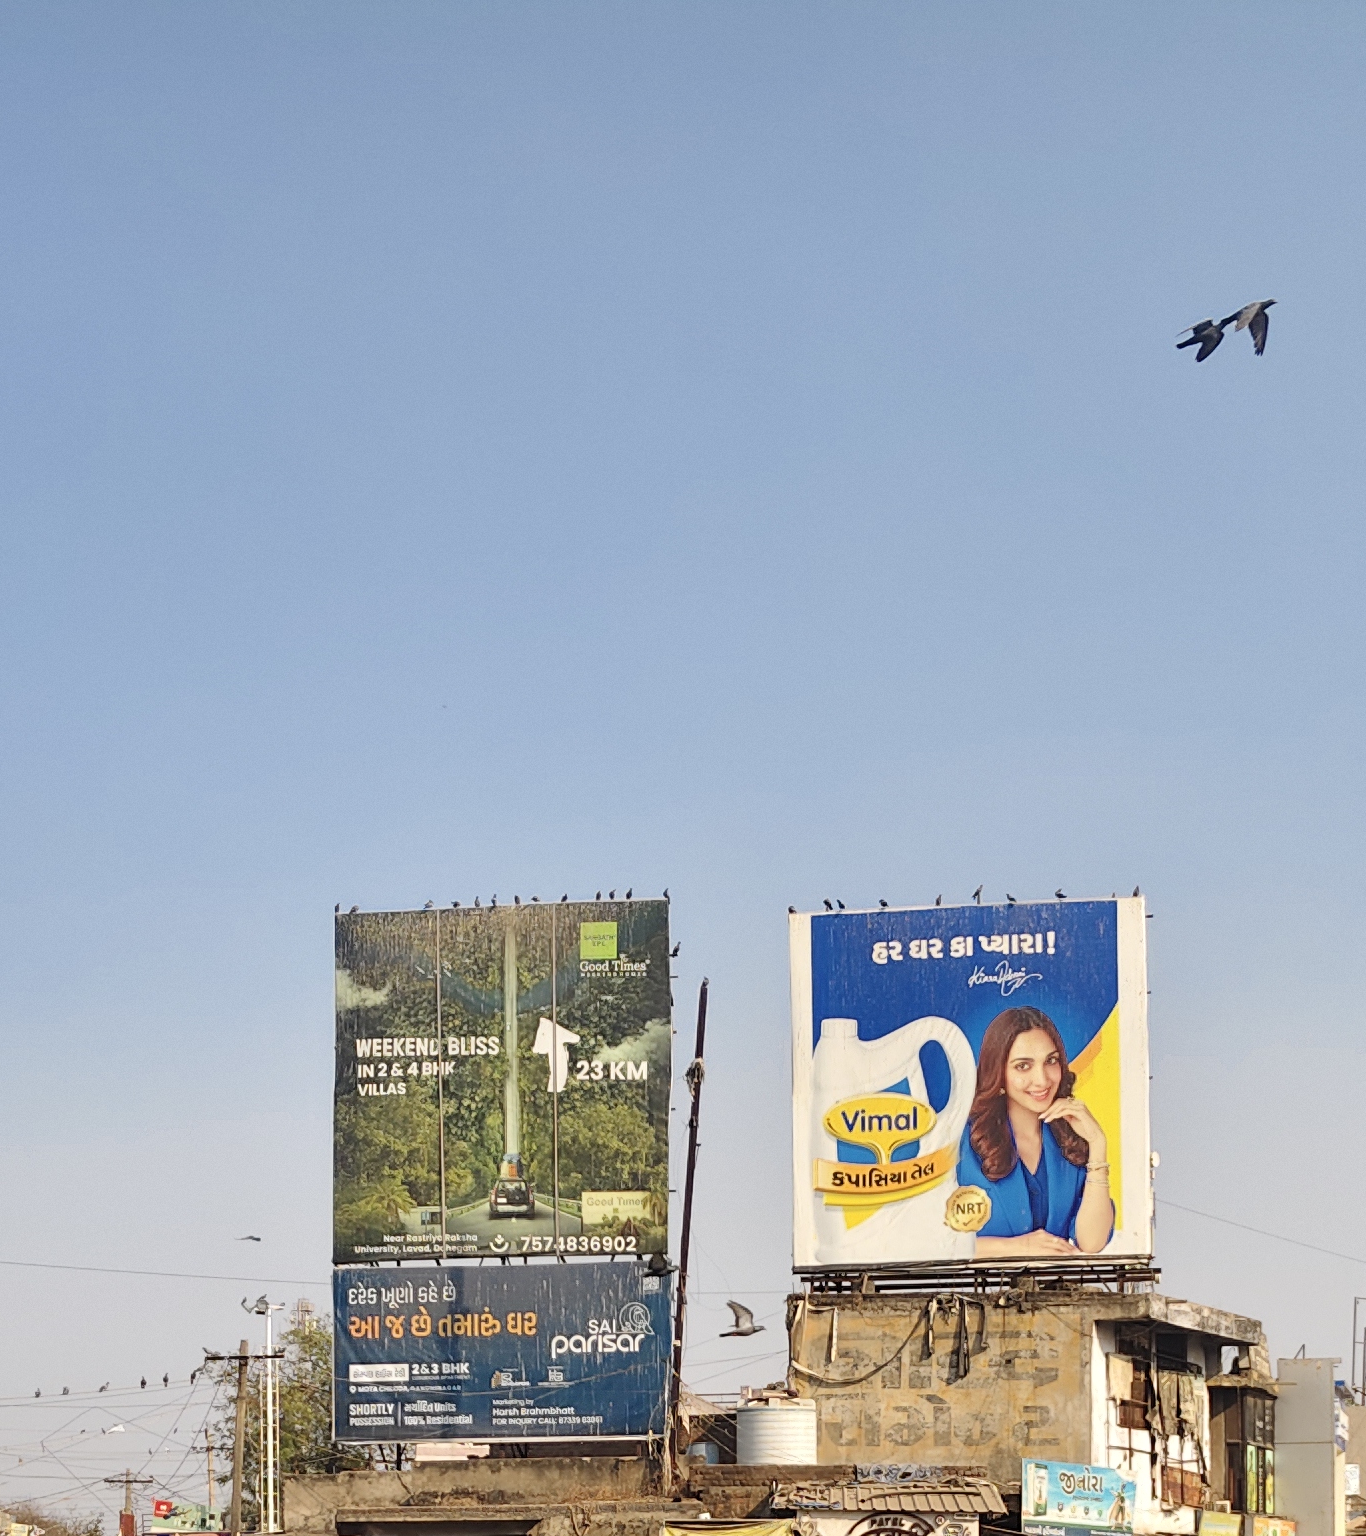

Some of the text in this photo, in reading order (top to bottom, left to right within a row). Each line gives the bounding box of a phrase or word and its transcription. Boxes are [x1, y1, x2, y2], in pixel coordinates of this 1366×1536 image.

[871, 940, 903, 964] હર
[908, 938, 943, 959] ઘર
[950, 936, 974, 958] કા
[580, 960, 609, 971] Good
[356, 1036, 500, 1058] WEEKEND BLISS
[358, 1062, 455, 1078] IN 2 & 4 BHK
[576, 1061, 648, 1081] 23 KM
[358, 1082, 407, 1097] VILLAS
[841, 1107, 918, 1132] Vimal
[831, 1161, 935, 1189] કપાસિયા તેલ
[586, 1197, 614, 1207] Good
[956, 1203, 984, 1214] NRT
[383, 1235, 405, 1243] Near
[521, 1236, 637, 1251] 7574836902
[348, 1282, 377, 1305] દરેક
[418, 1280, 438, 1303] કહે
[442, 1280, 456, 1302] છે
[348, 1306, 537, 1339] આ જ છે તમારું ઘર
[588, 1319, 618, 1335] SAI
[551, 1333, 646, 1359] parisar
[442, 1363, 470, 1374] BHK
[349, 1403, 394, 1415] SHORTLY
[434, 1402, 456, 1412] Units
[492, 1406, 575, 1416] Harsh Brahmbhatt
[426, 1414, 473, 1425] Residential
[869, 1516, 906, 1529] PATEL
